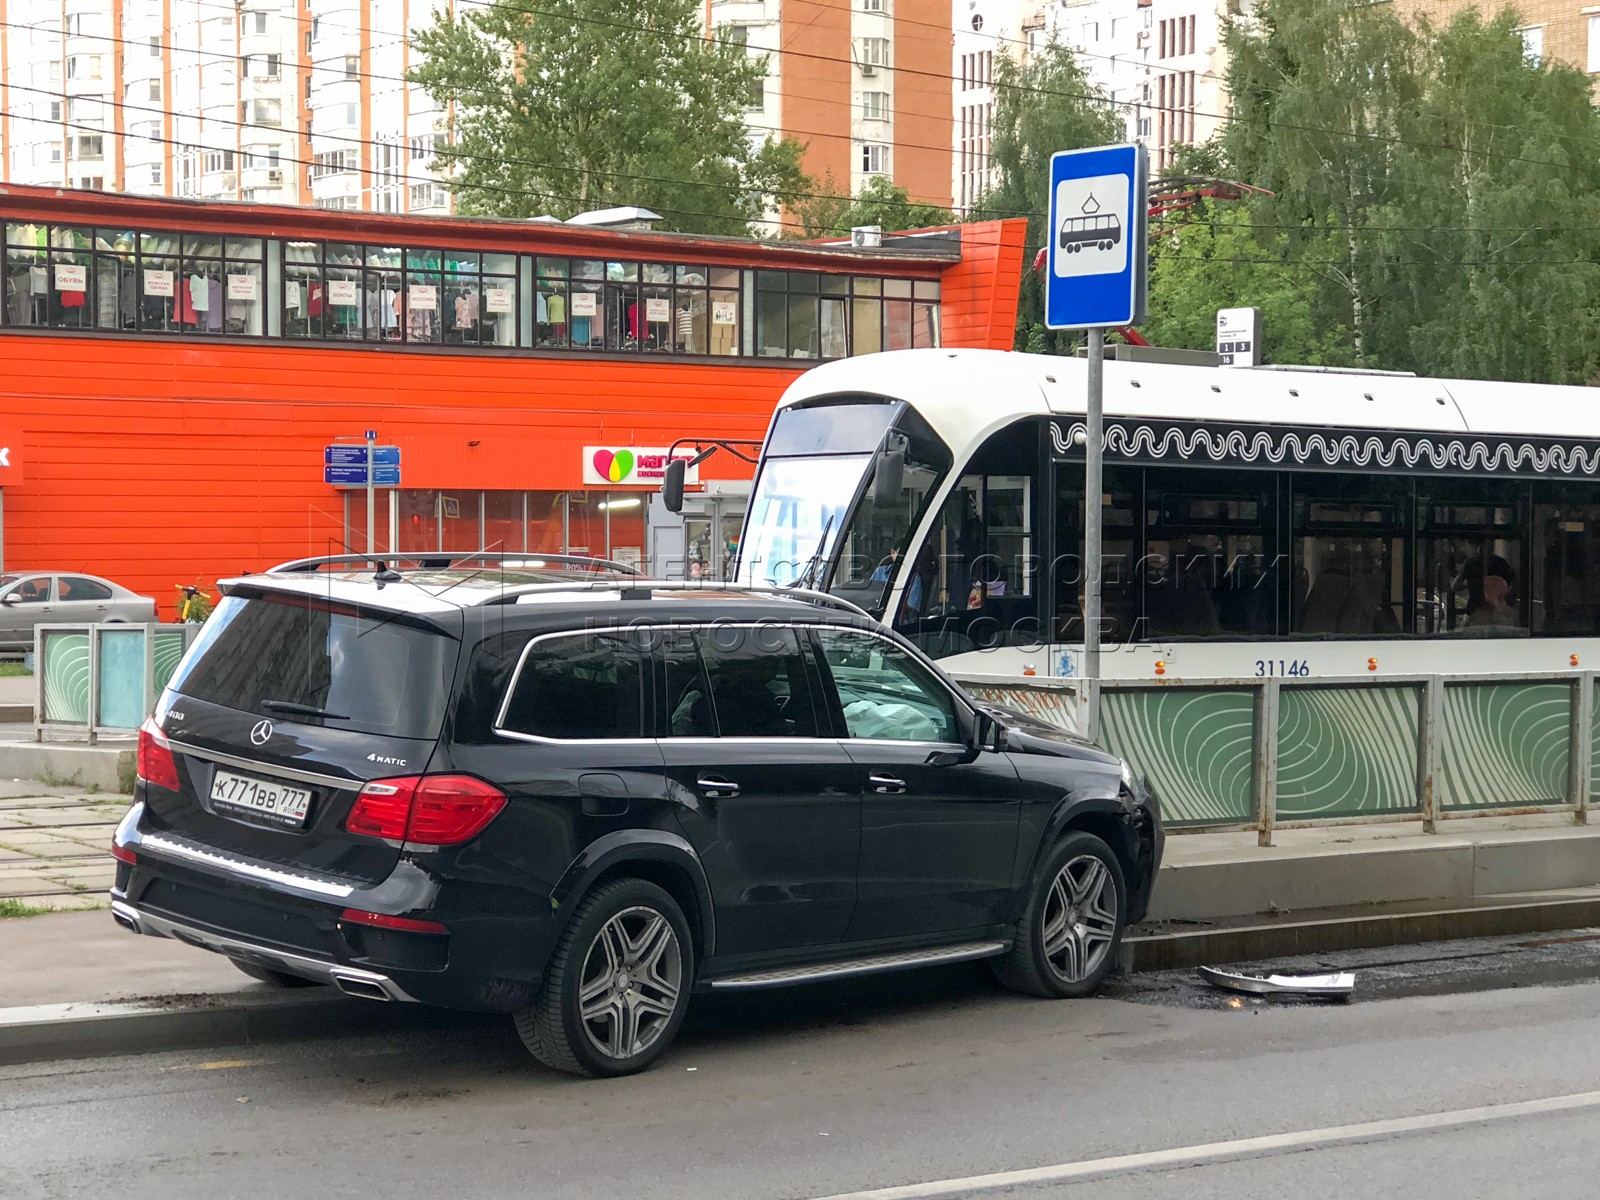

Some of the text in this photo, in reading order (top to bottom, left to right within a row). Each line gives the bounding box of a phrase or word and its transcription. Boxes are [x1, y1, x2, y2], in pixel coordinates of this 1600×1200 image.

[57, 276, 83, 284] ОБУВЬ
[1224, 342, 1246, 352] 1 3
[1222, 355, 1231, 364] 16
[1255, 659, 1310, 677] 31146
[366, 753, 407, 767] 4MATIC
[281, 788, 306, 809] 777
[283, 806, 296, 815] RUS
